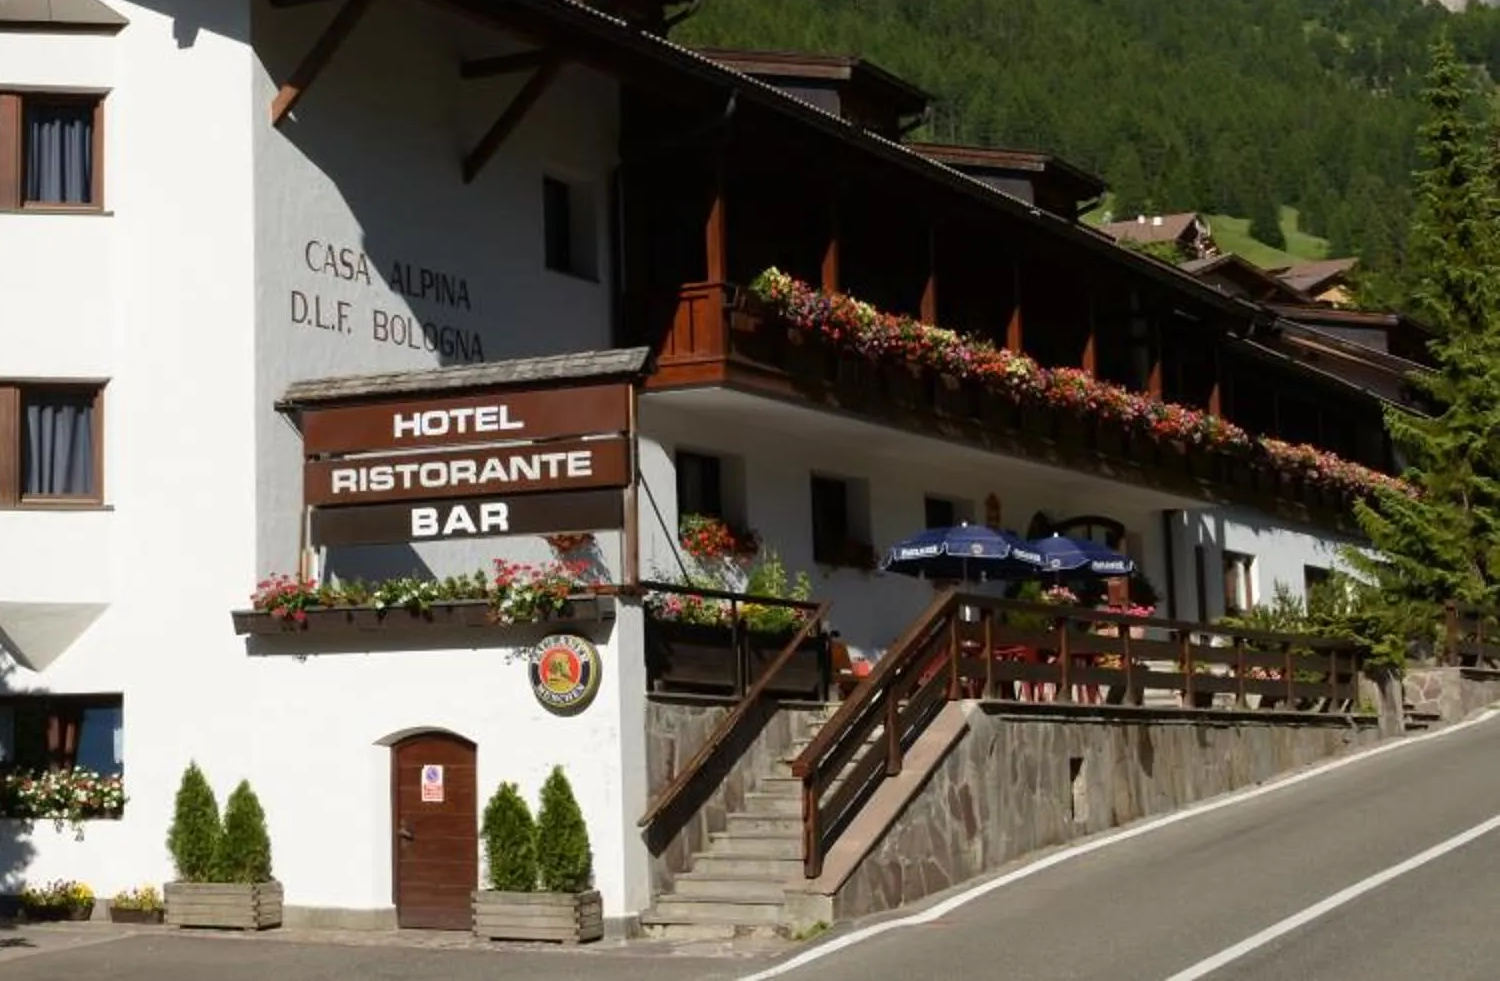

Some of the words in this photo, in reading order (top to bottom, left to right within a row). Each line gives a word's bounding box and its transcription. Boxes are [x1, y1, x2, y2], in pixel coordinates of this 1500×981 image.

[305, 240, 371, 286] CASA
[390, 260, 472, 312] ALPINA
[290, 290, 352, 334] D.L.F.
[372, 309, 485, 363] BOLOGNA
[393, 404, 524, 438] HOTEL
[331, 450, 593, 494] RISTORANTE
[411, 502, 509, 537] BAR
